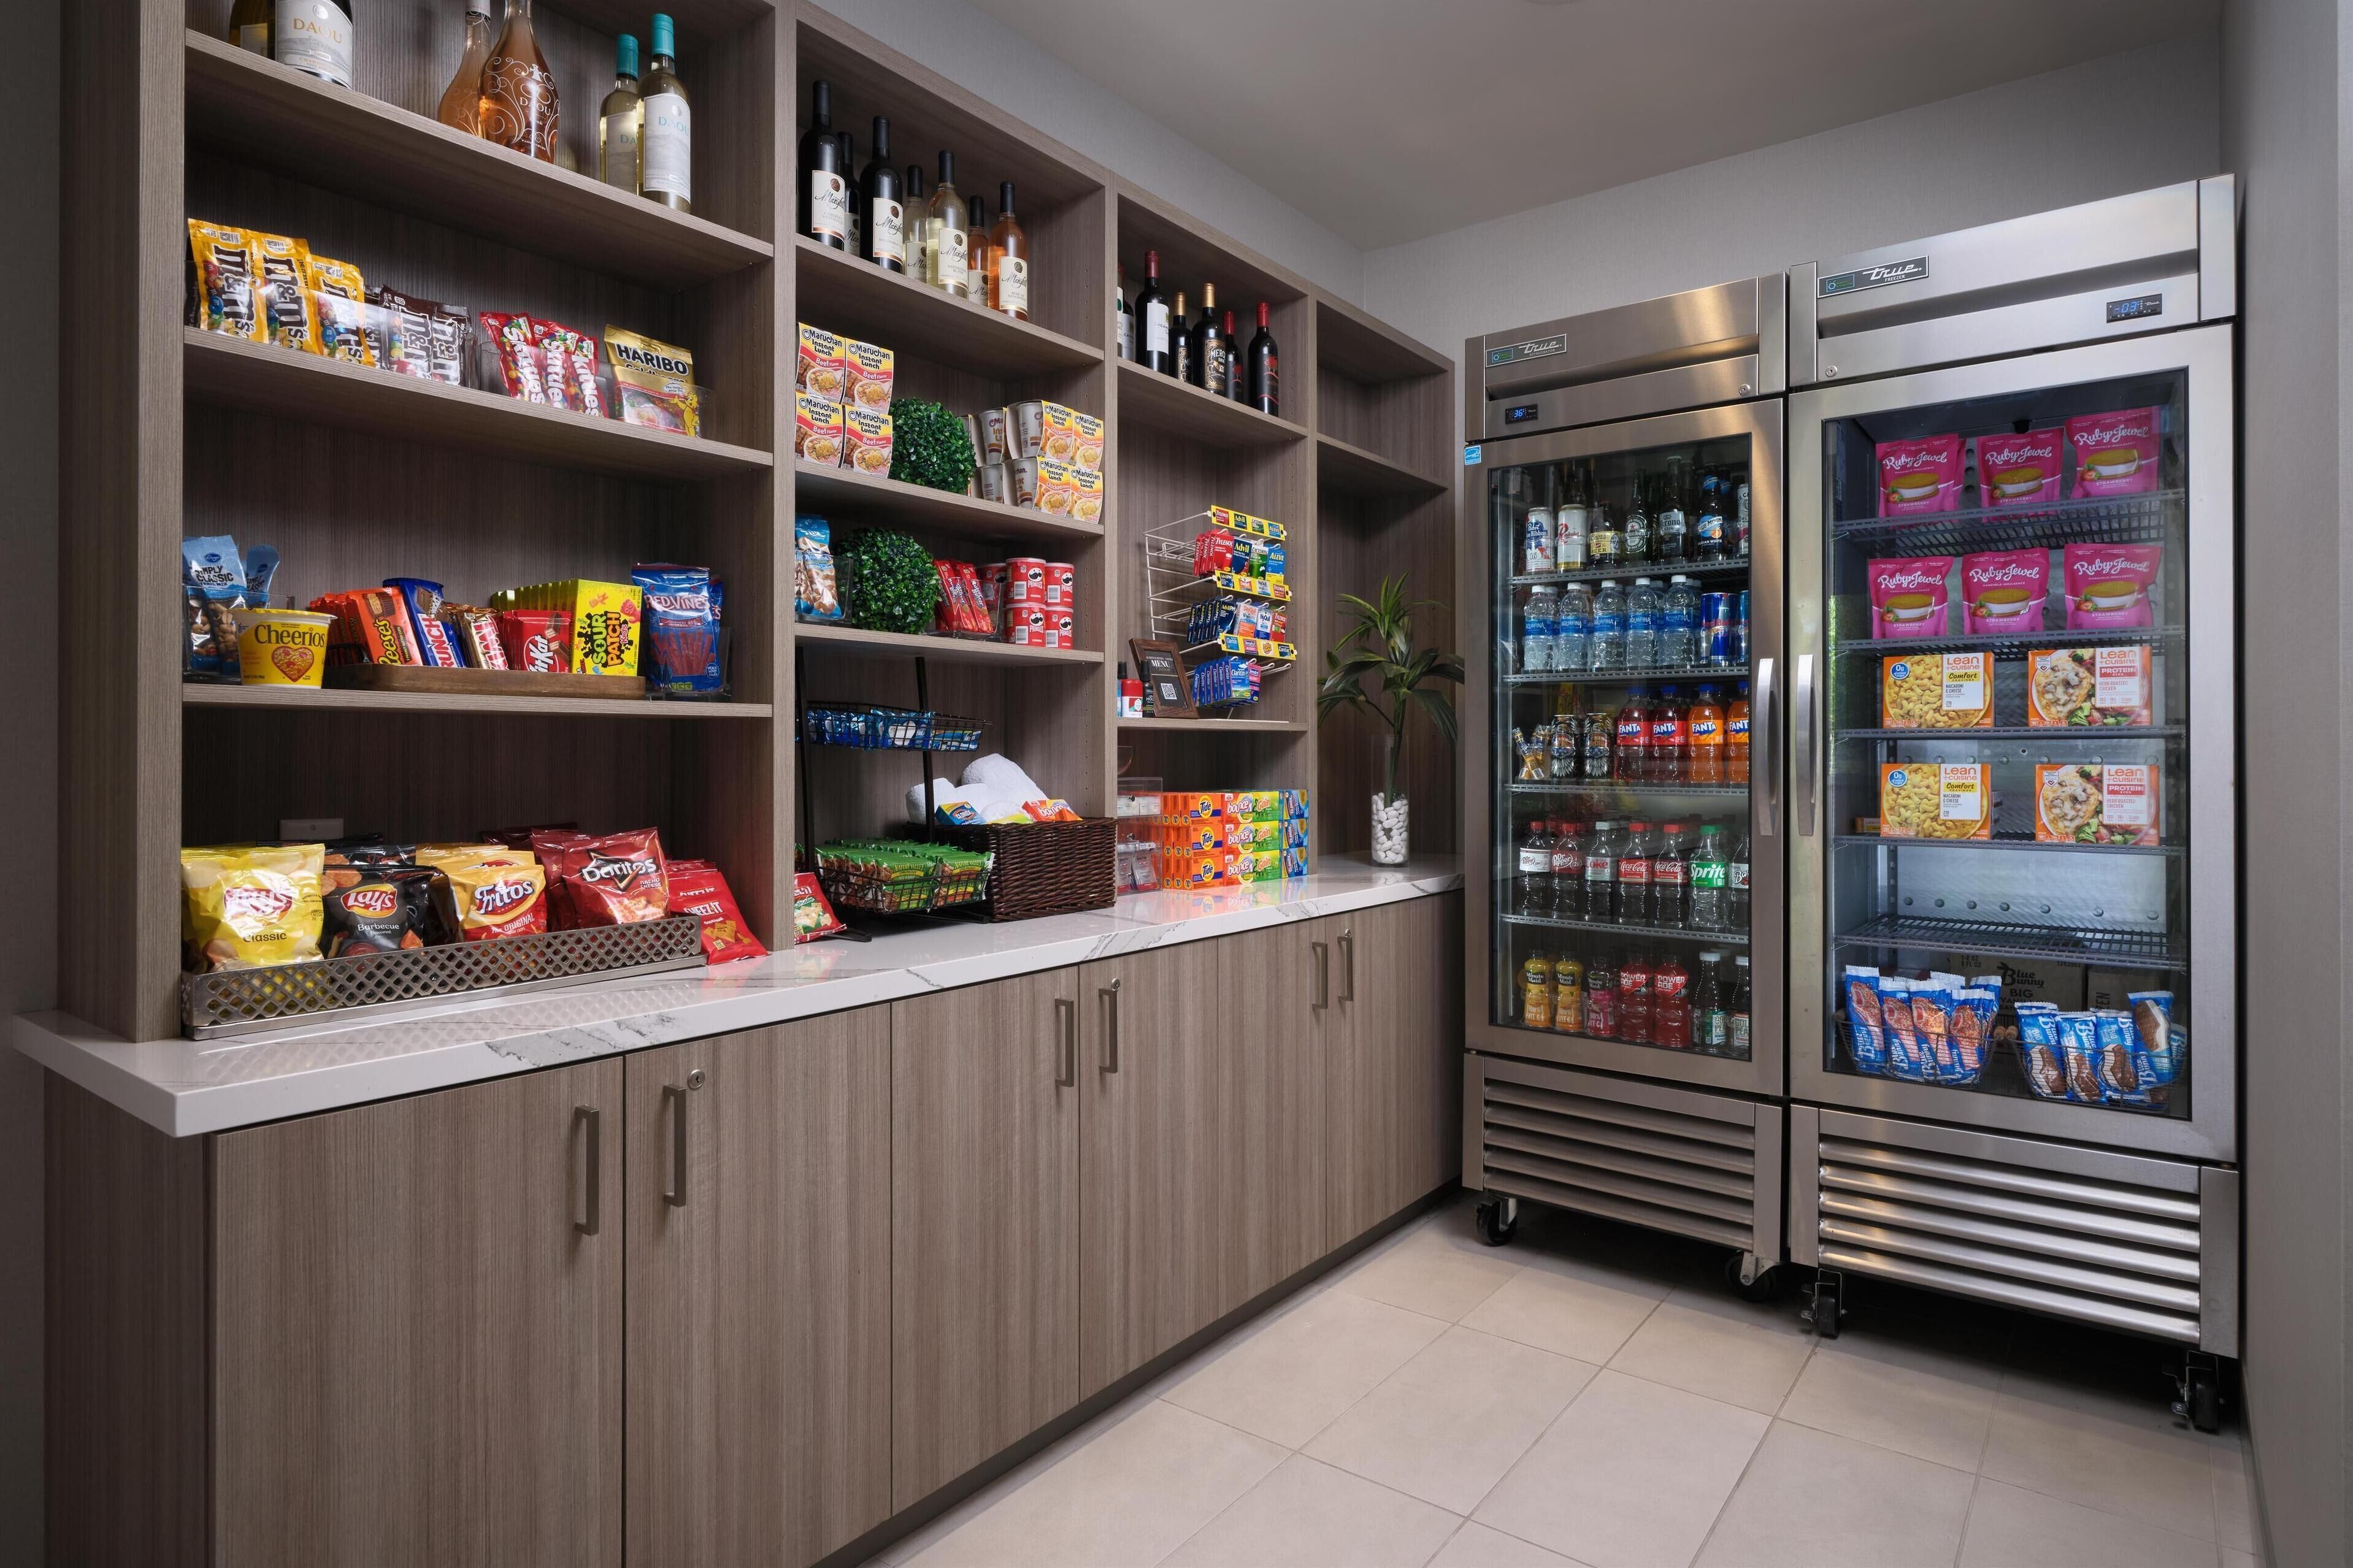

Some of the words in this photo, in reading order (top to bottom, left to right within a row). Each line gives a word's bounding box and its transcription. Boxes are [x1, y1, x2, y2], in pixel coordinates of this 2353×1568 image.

[809, 329, 842, 348] Maruchan
[812, 339, 835, 352] Instant
[815, 346, 832, 357] Lunch
[856, 344, 890, 359] Maruchan
[616, 343, 688, 375] HARIBO
[816, 357, 829, 367] Beef
[859, 353, 882, 364] Instant
[861, 360, 880, 369] Lunch
[863, 371, 877, 380] Beef
[807, 398, 839, 414] Maruchan
[1049, 405, 1072, 418] Maruchan
[808, 408, 832, 419] Instant
[856, 411, 889, 426] Maruchan
[1051, 413, 1066, 422] Instant
[811, 415, 829, 424] Lunch
[859, 419, 881, 430] Instant
[1080, 416, 1102, 429] Maruchan
[813, 426, 827, 434] Beef
[861, 427, 879, 435] Lunch
[1081, 423, 1096, 432] Instant
[2074, 429, 2113, 445] Ruby
[2111, 424, 2149, 443] Jewel
[1883, 454, 1916, 470] Ruby
[1913, 451, 1948, 466] Jewel
[1985, 449, 2021, 465] Ruby
[2018, 446, 2052, 462] Jewel
[1045, 461, 1069, 473] Maruchan
[1047, 468, 1063, 477] Instant
[1077, 470, 1100, 481] Maruchan
[1216, 510, 1229, 518] TYLENOL
[1708, 517, 1722, 527] MOON
[1558, 522, 1581, 545] Rainier
[1216, 537, 1233, 546] TYLENOL
[1235, 542, 1249, 553] Advil
[1270, 553, 1284, 561] ALEVE
[194, 565, 223, 575] SIMPLY
[2074, 559, 2113, 575] Ruby
[2111, 557, 2149, 574] Jewel
[196, 573, 234, 582] CLASSIC
[1969, 567, 2006, 582] Ruby
[2003, 564, 2040, 579] Jewel
[1878, 572, 1911, 589] Ruby
[1910, 571, 1942, 588] Jewel
[671, 594, 710, 610] VINES
[1275, 613, 1286, 622] TYLENOL
[254, 624, 325, 648] Cheerios
[592, 614, 607, 665] SOUR
[606, 611, 621, 667] PATCH
[620, 624, 629, 644] Kids
[421, 613, 454, 667] RUNCH
[2100, 650, 2136, 659] Lean
[1947, 657, 1979, 665] Lean
[1619, 724, 1641, 734] FANTA
[1653, 724, 1676, 734] FANTA
[1692, 722, 1716, 733] FANTA
[2108, 768, 2144, 777] Lean
[1200, 801, 1211, 814] Tide
[1228, 798, 1249, 813] bounce
[1257, 798, 1270, 812] Gain
[956, 809, 972, 819] CLOROX
[1202, 833, 1213, 846] Tide
[1228, 830, 1249, 845] bounce
[1257, 828, 1270, 841] Gain
[895, 863, 910, 873] NATURE
[910, 863, 924, 871] VALLEY
[1228, 860, 1249, 876] bounce
[1257, 858, 1271, 871] Gain
[1553, 857, 1572, 868] Pepper
[1586, 860, 1608, 869] Coke
[1621, 861, 1648, 872] Coca-Cola
[1655, 861, 1682, 872] Coca-Cola
[582, 859, 658, 882] Doritos
[1202, 864, 1213, 878] Tide
[1691, 863, 1725, 879] Sprite
[347, 892, 393, 912] Lay's
[474, 881, 534, 915] Fritos
[497, 903, 516, 913] BRAND
[358, 923, 399, 931] Barbecue
[504, 913, 535, 931] ORIGINAL
[244, 932, 287, 943] Classic
[1620, 972, 1646, 981] POWER
